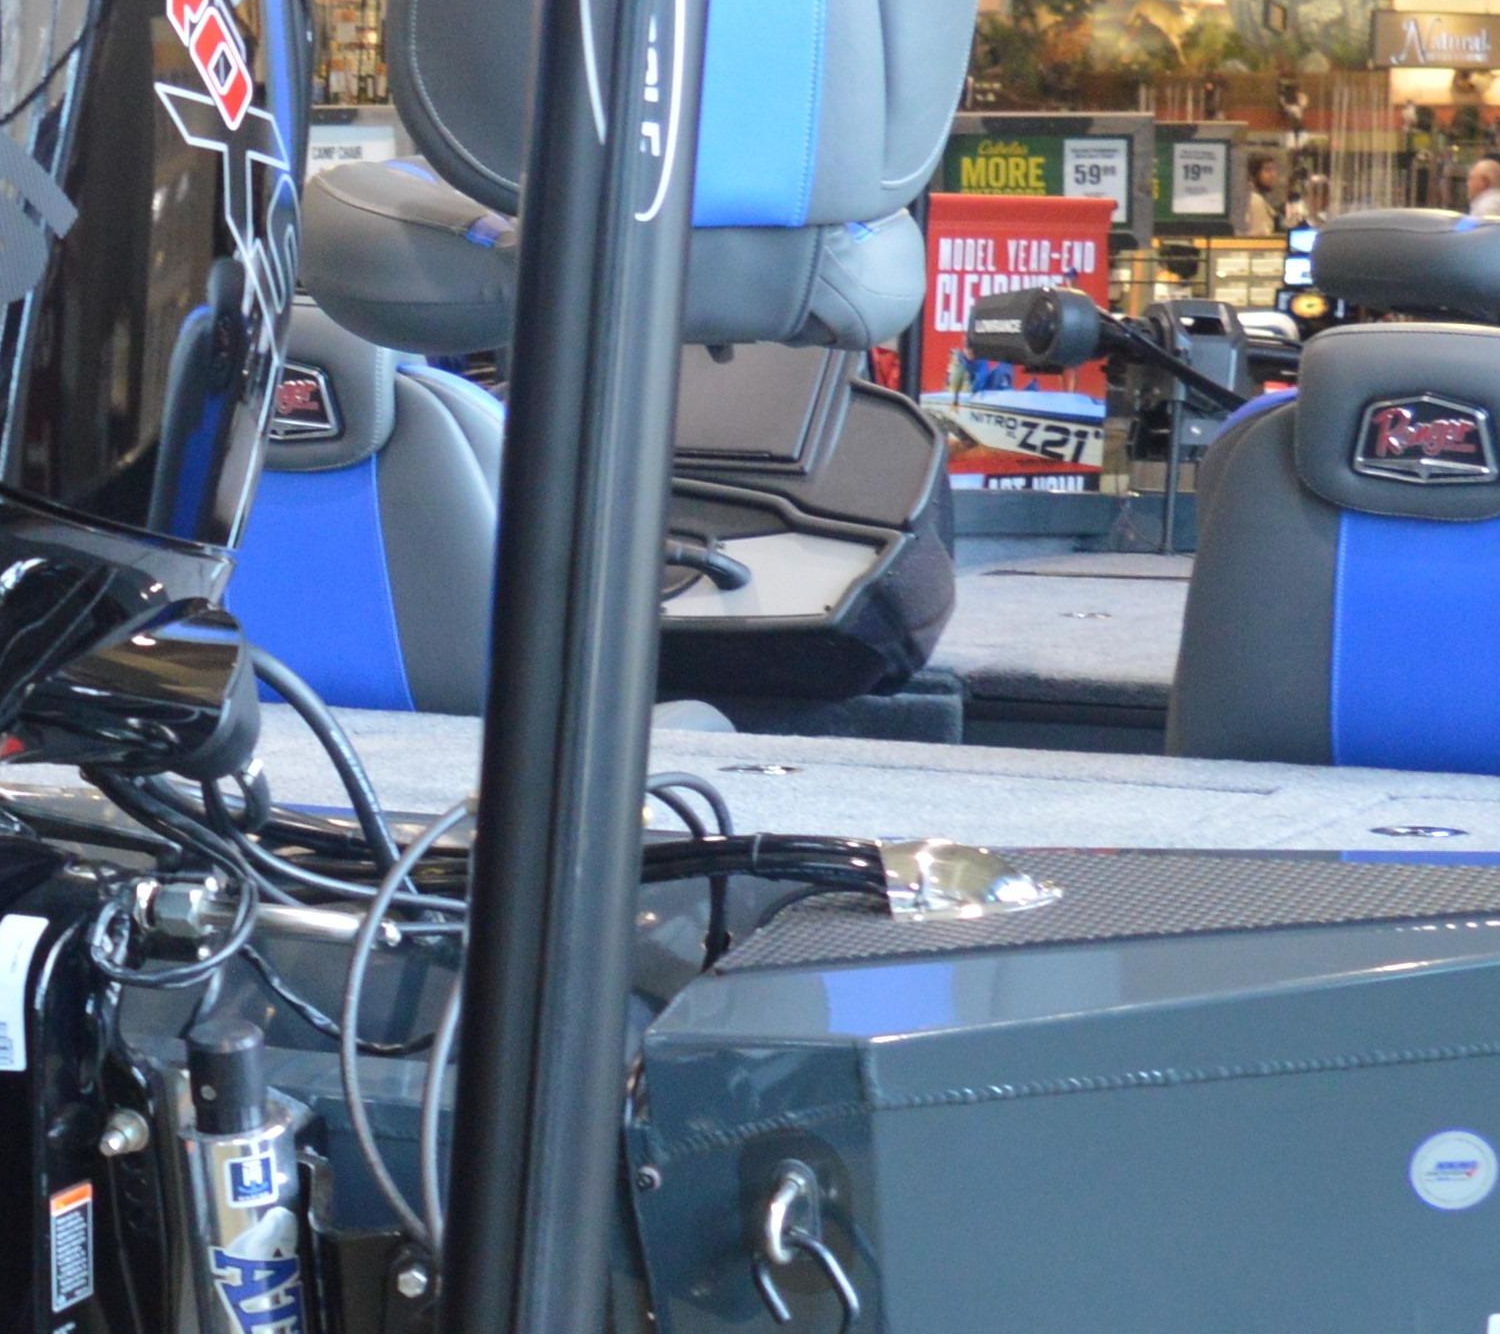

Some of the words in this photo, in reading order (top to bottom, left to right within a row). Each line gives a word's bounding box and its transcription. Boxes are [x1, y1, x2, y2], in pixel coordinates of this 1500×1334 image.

[961, 156, 1047, 187] MORE
[938, 237, 996, 272] MODEL
[1007, 239, 1096, 273] YEAR-END
